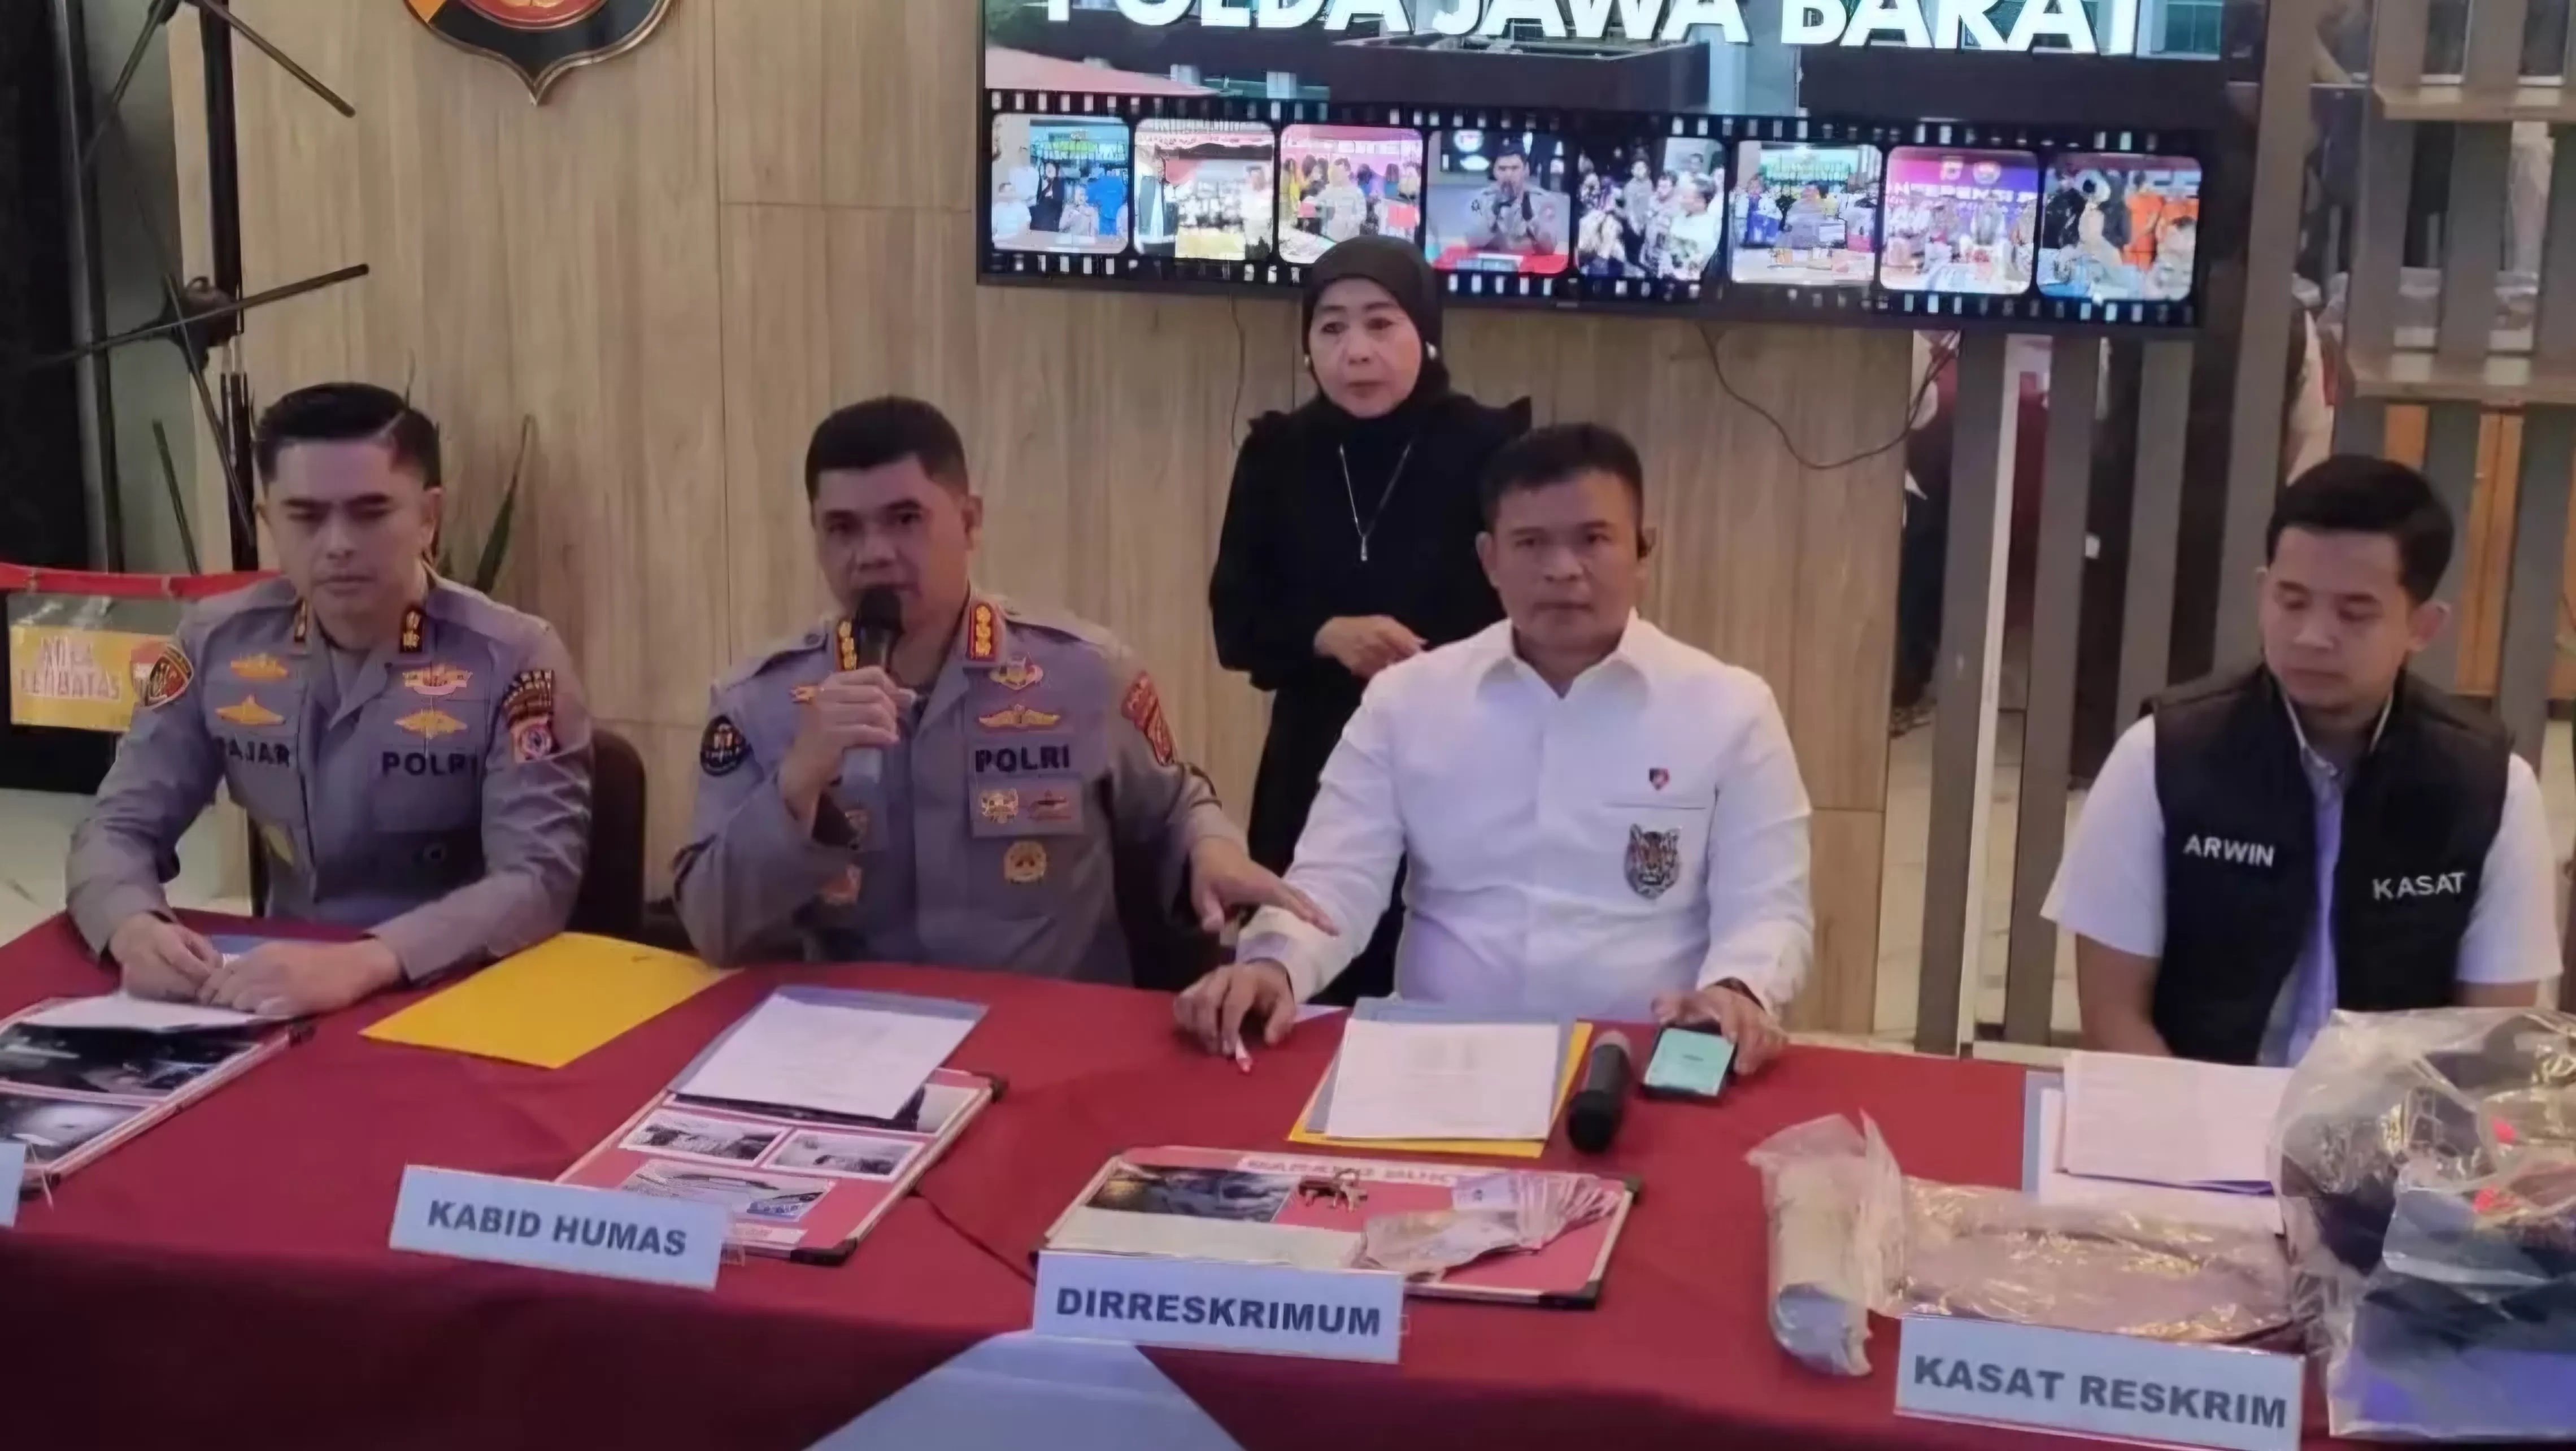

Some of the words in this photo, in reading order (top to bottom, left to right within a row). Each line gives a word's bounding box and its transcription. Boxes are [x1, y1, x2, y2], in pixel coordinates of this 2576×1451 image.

[382, 751, 478, 777] POLRI
[975, 744, 1070, 773] POLRI
[2183, 834, 2275, 868] ARWIN
[2373, 872, 2466, 901] KASAT
[427, 1200, 541, 1238] KABID
[552, 1214, 687, 1257] HUMAS
[1055, 1287, 1382, 1336] DIRRESKRIMUM
[1913, 1355, 2065, 1401] KASAT
[2079, 1375, 2288, 1429] RESKRIM
